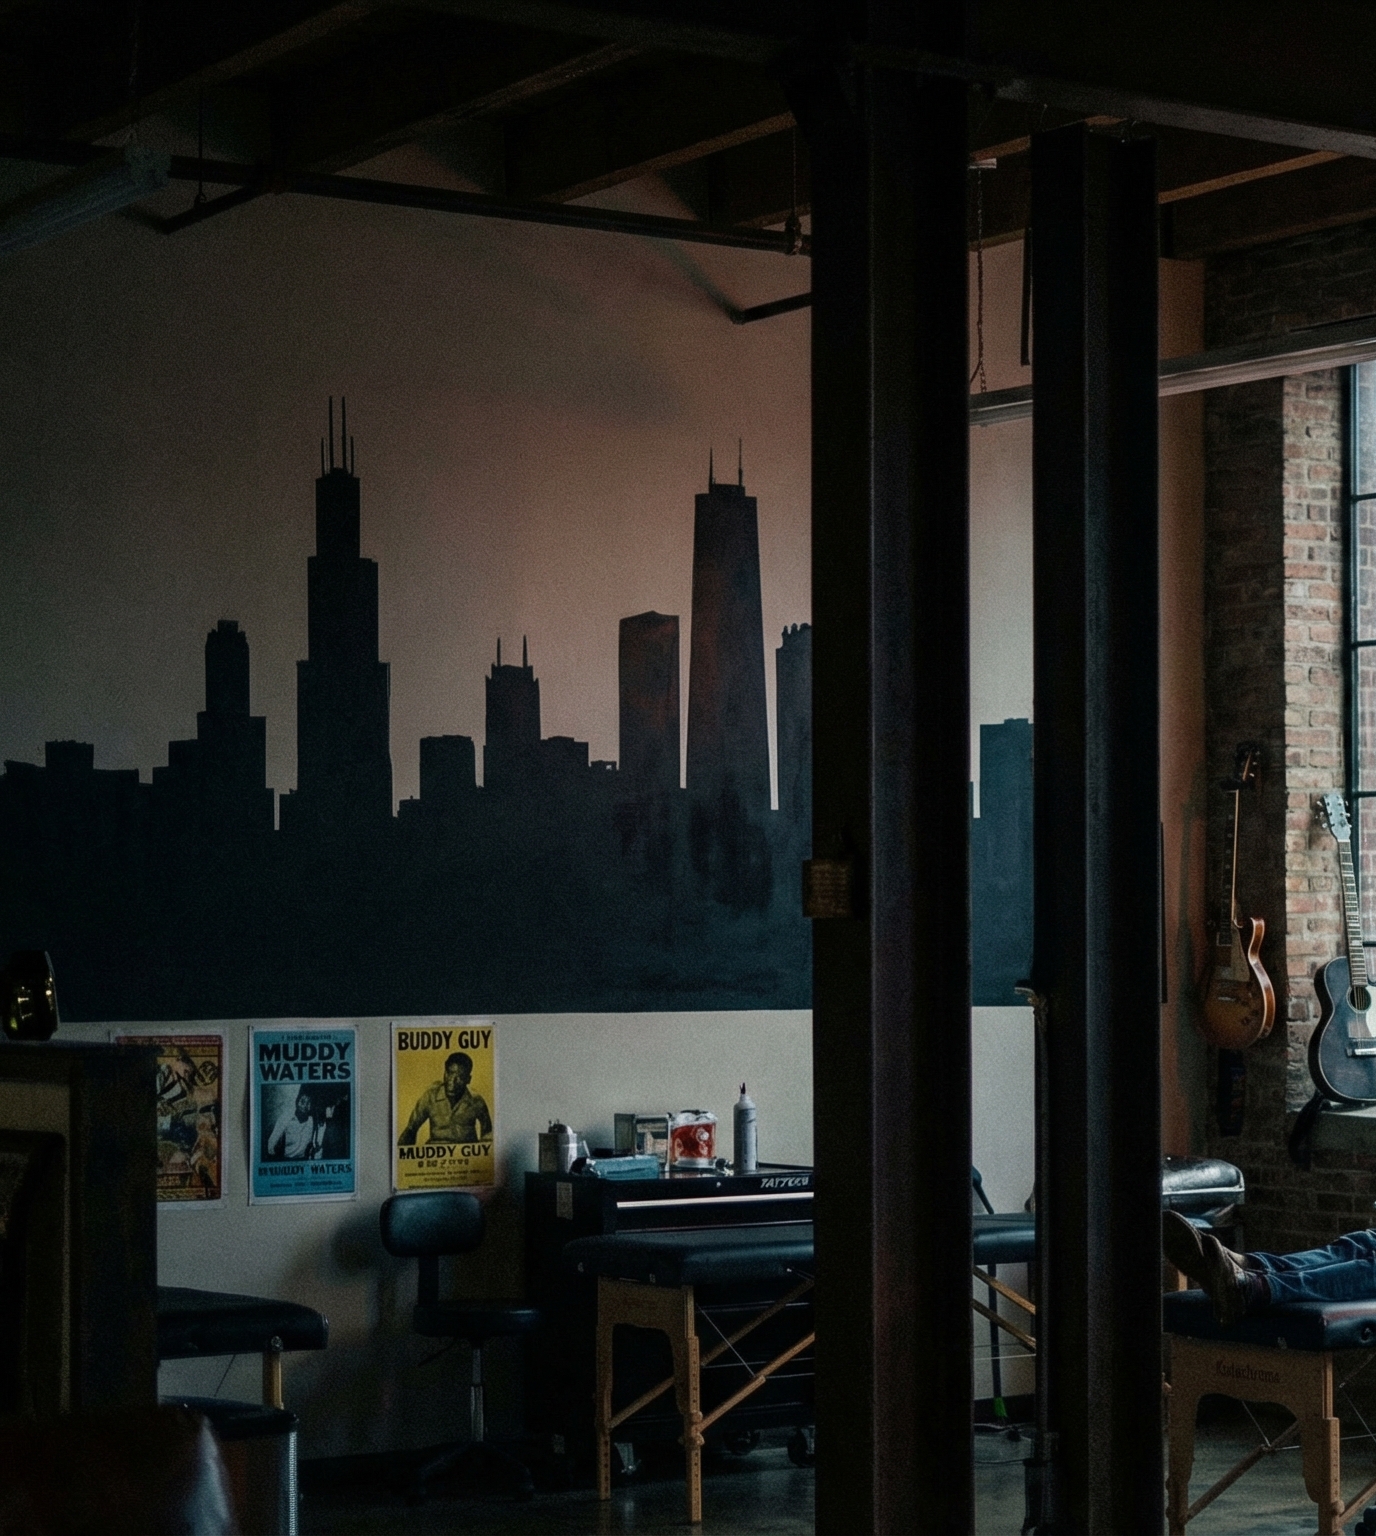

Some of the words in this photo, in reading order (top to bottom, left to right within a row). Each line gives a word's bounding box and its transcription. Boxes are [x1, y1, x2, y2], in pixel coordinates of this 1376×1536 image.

[399, 1031, 450, 1050] BUDDY
[457, 1030, 491, 1049] GUY
[258, 1043, 351, 1062] MUDDY
[259, 1063, 351, 1081] WATERS
[399, 1146, 456, 1160] MUDDY
[461, 1144, 491, 1157] GUY
[310, 1163, 352, 1175] WATERS
